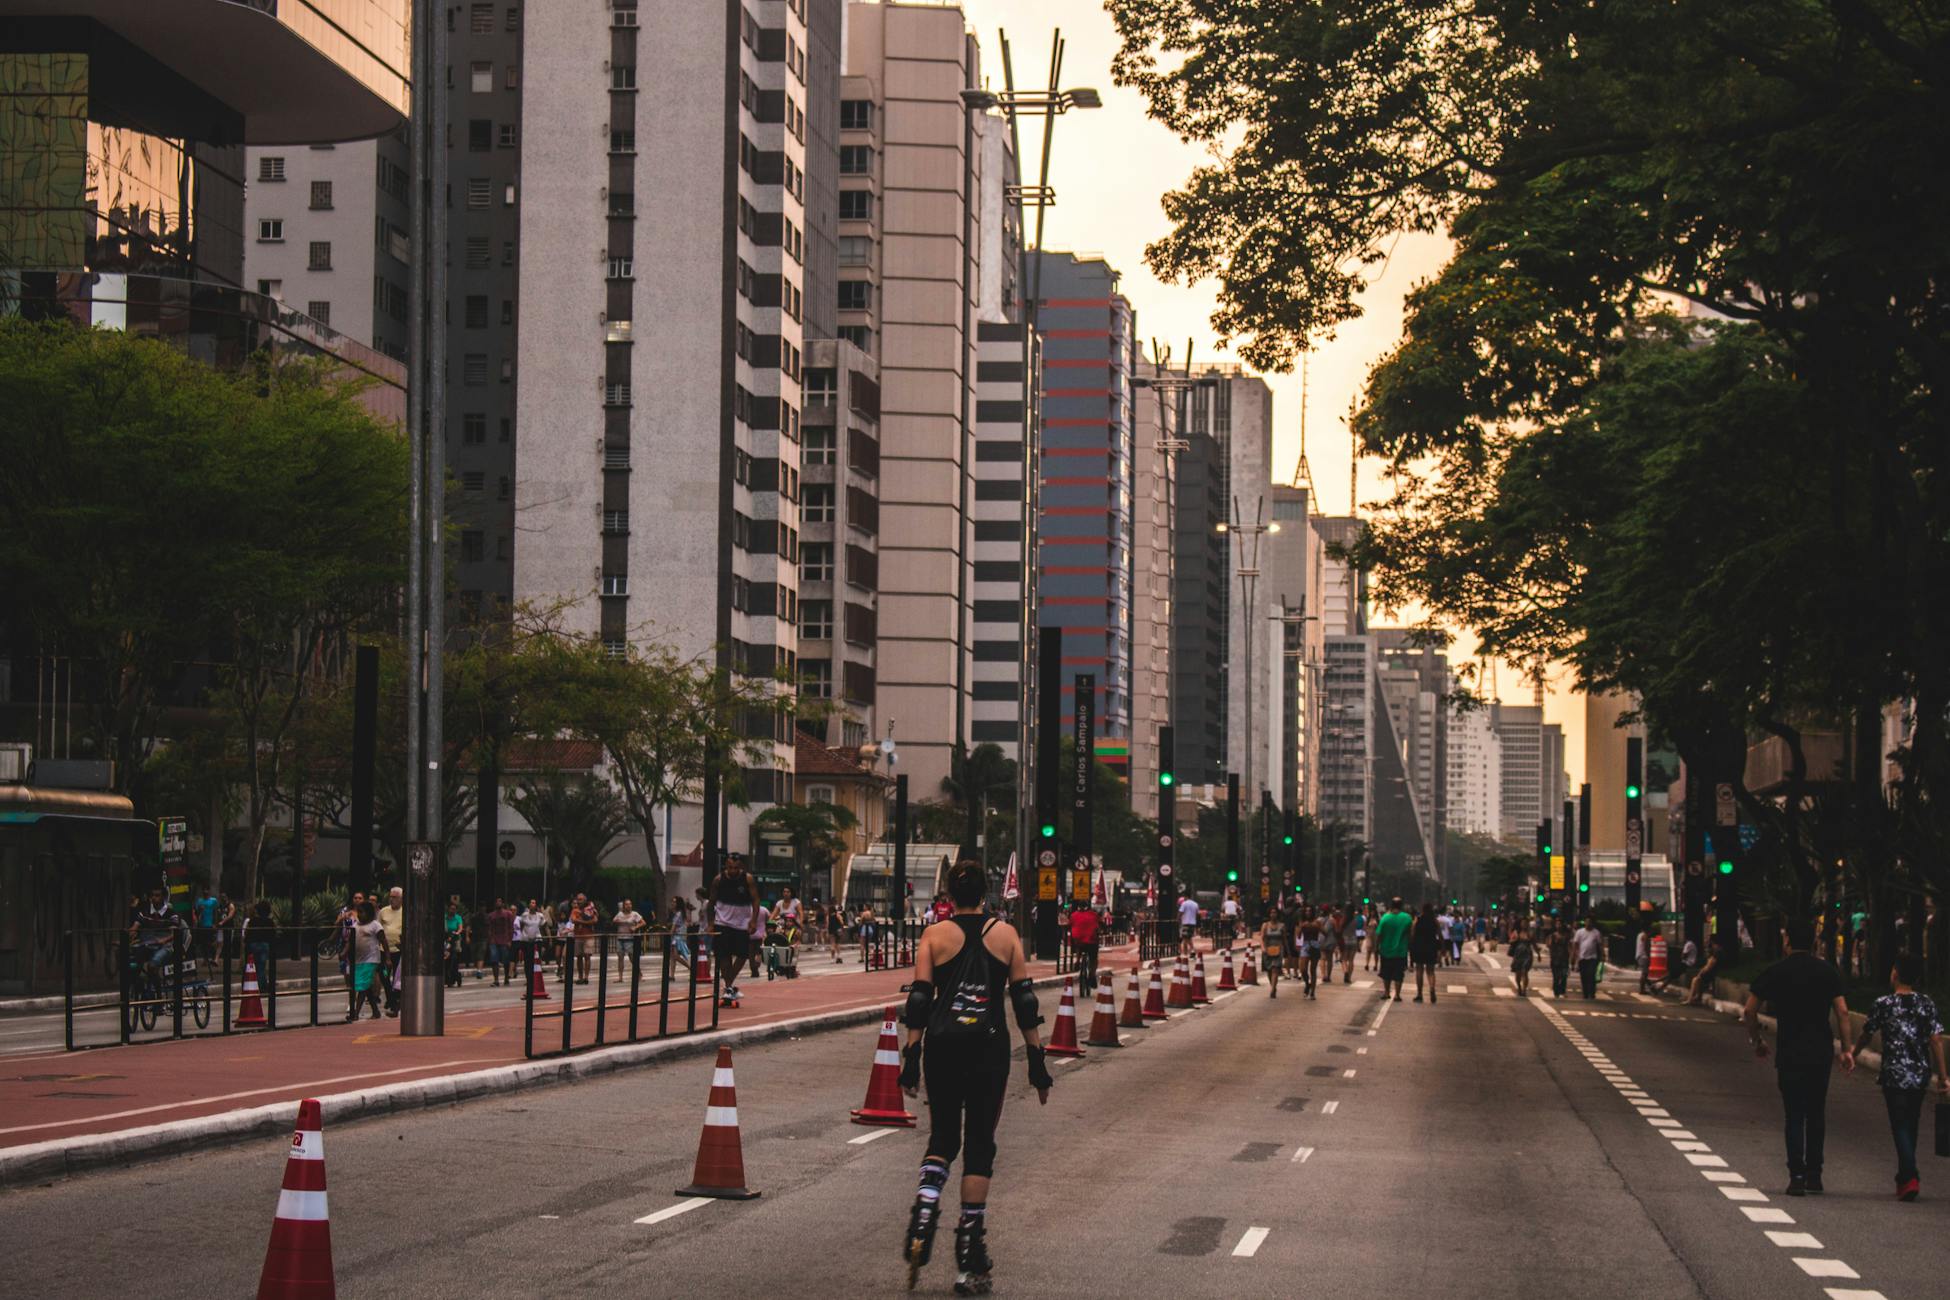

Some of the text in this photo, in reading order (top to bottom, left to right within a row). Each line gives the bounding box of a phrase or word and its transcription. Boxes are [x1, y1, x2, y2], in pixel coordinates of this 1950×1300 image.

[1076, 705, 1088, 808] R Carlos Sampaio
